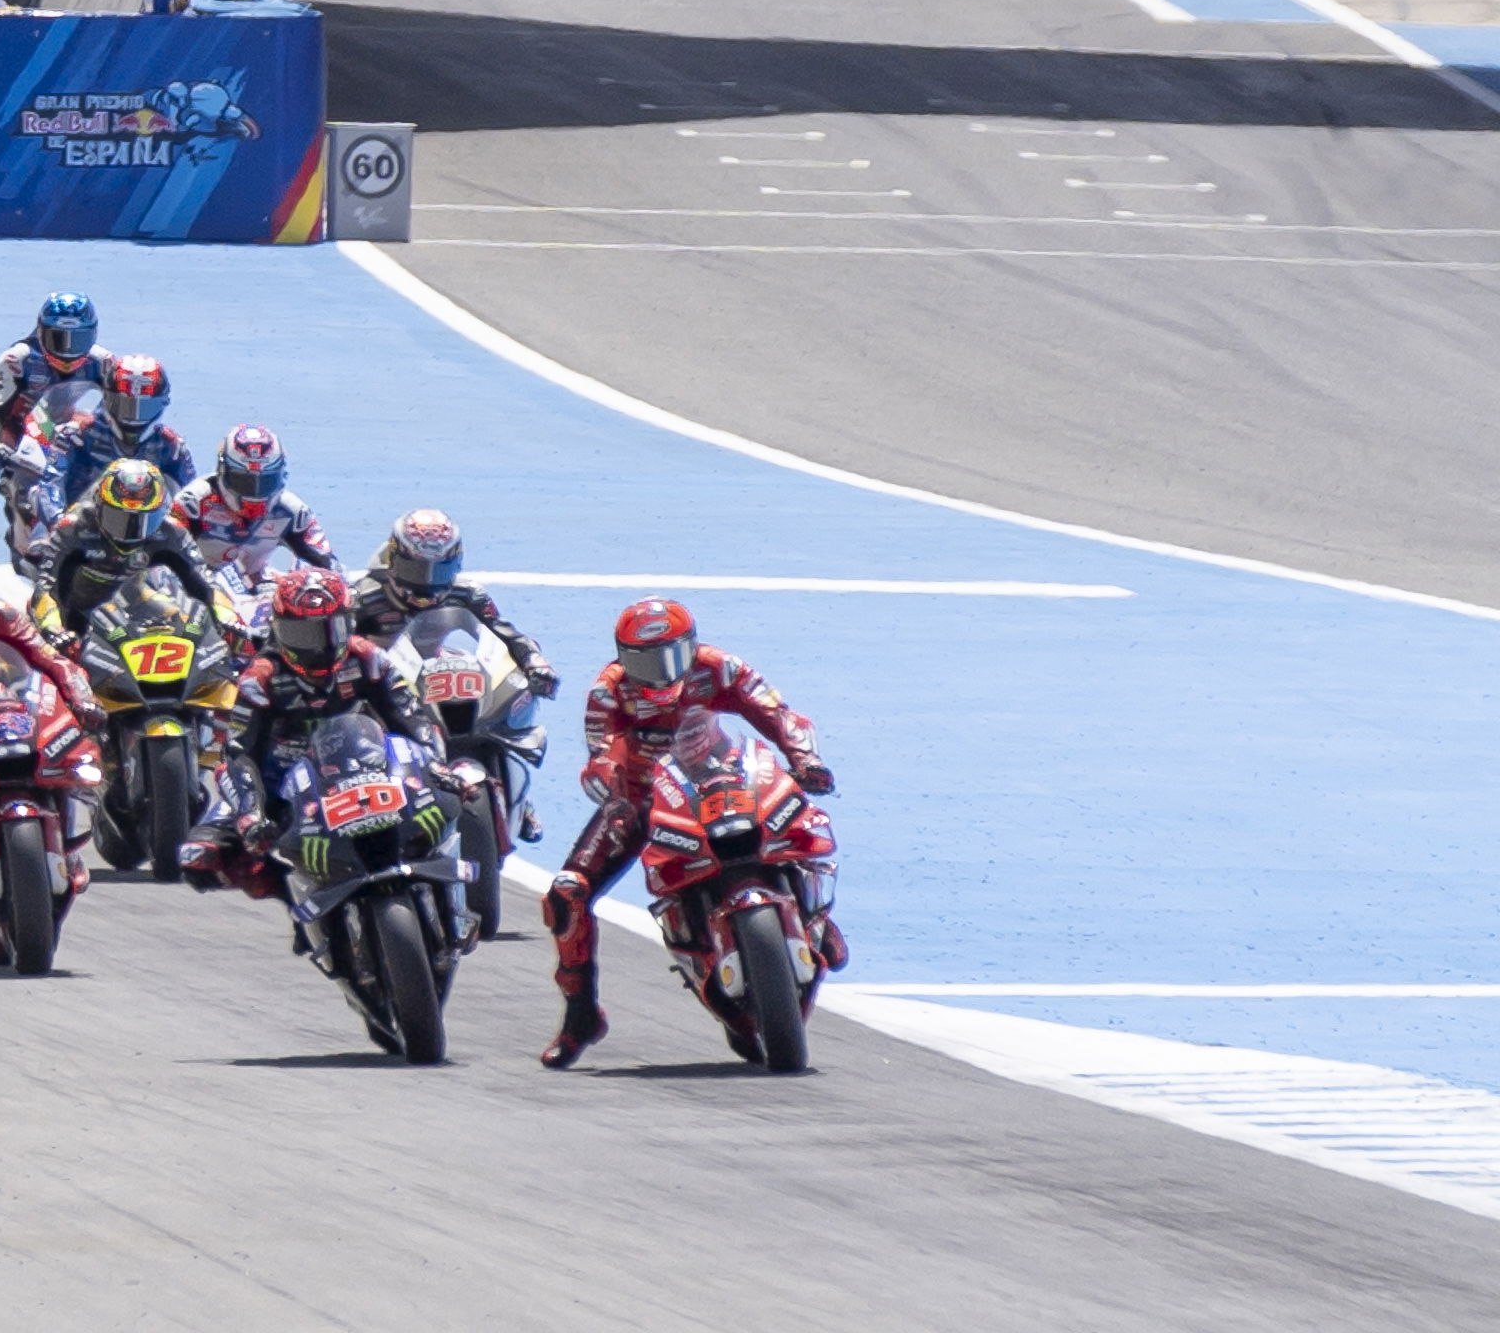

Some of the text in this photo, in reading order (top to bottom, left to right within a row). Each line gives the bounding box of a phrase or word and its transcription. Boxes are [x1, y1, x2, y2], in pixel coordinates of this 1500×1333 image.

[35, 95, 144, 110] GRAN PREMIO
[22, 111, 109, 134] Red Bull
[66, 136, 171, 166] ESPAÑA
[352, 153, 394, 180] 60
[129, 641, 190, 677] 72
[423, 670, 486, 704] 30
[44, 727, 82, 758] Lenovo
[321, 782, 408, 831] 20
[766, 797, 803, 832] Lenovo
[652, 828, 701, 851] Lenovo
